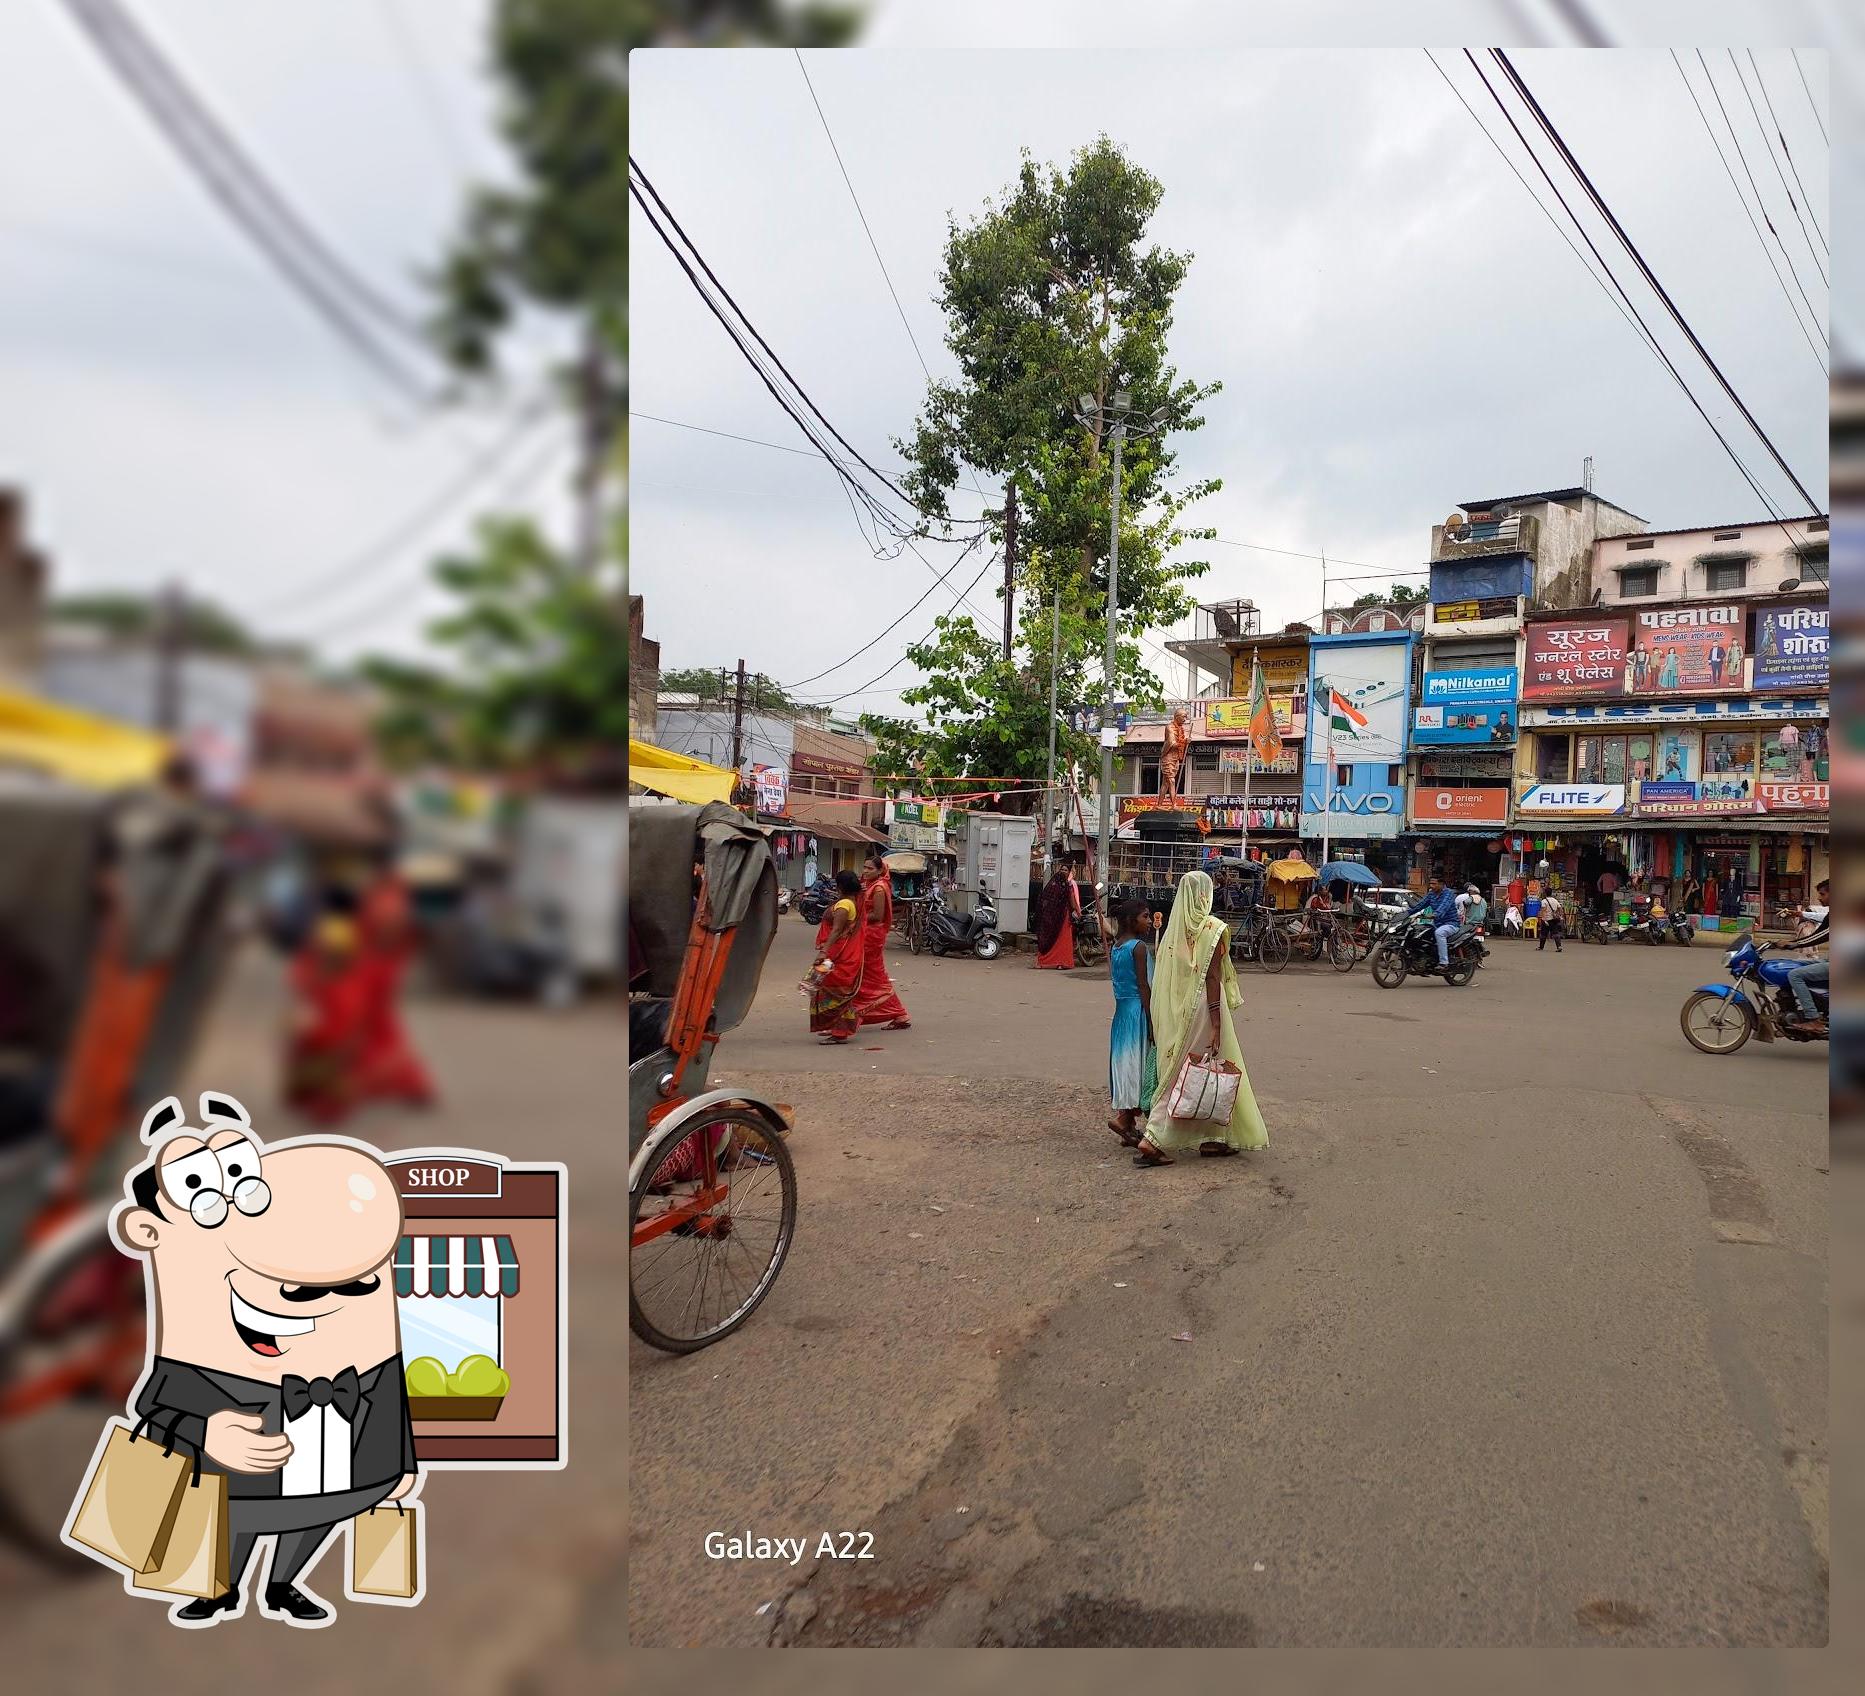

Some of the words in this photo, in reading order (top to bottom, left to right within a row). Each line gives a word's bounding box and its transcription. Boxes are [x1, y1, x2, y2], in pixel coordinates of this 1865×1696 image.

[1640, 606, 1739, 628] पहनावा
[1547, 628, 1611, 649] सूरज
[1534, 650, 1583, 663] जनरल
[1587, 645, 1622, 660] स्टोर
[1448, 675, 1510, 688] Nilkamal
[1556, 668, 1573, 684] शू
[1574, 663, 1614, 679] पैलेस
[1455, 794, 1483, 802] orient
[1539, 792, 1590, 804] FLITE
